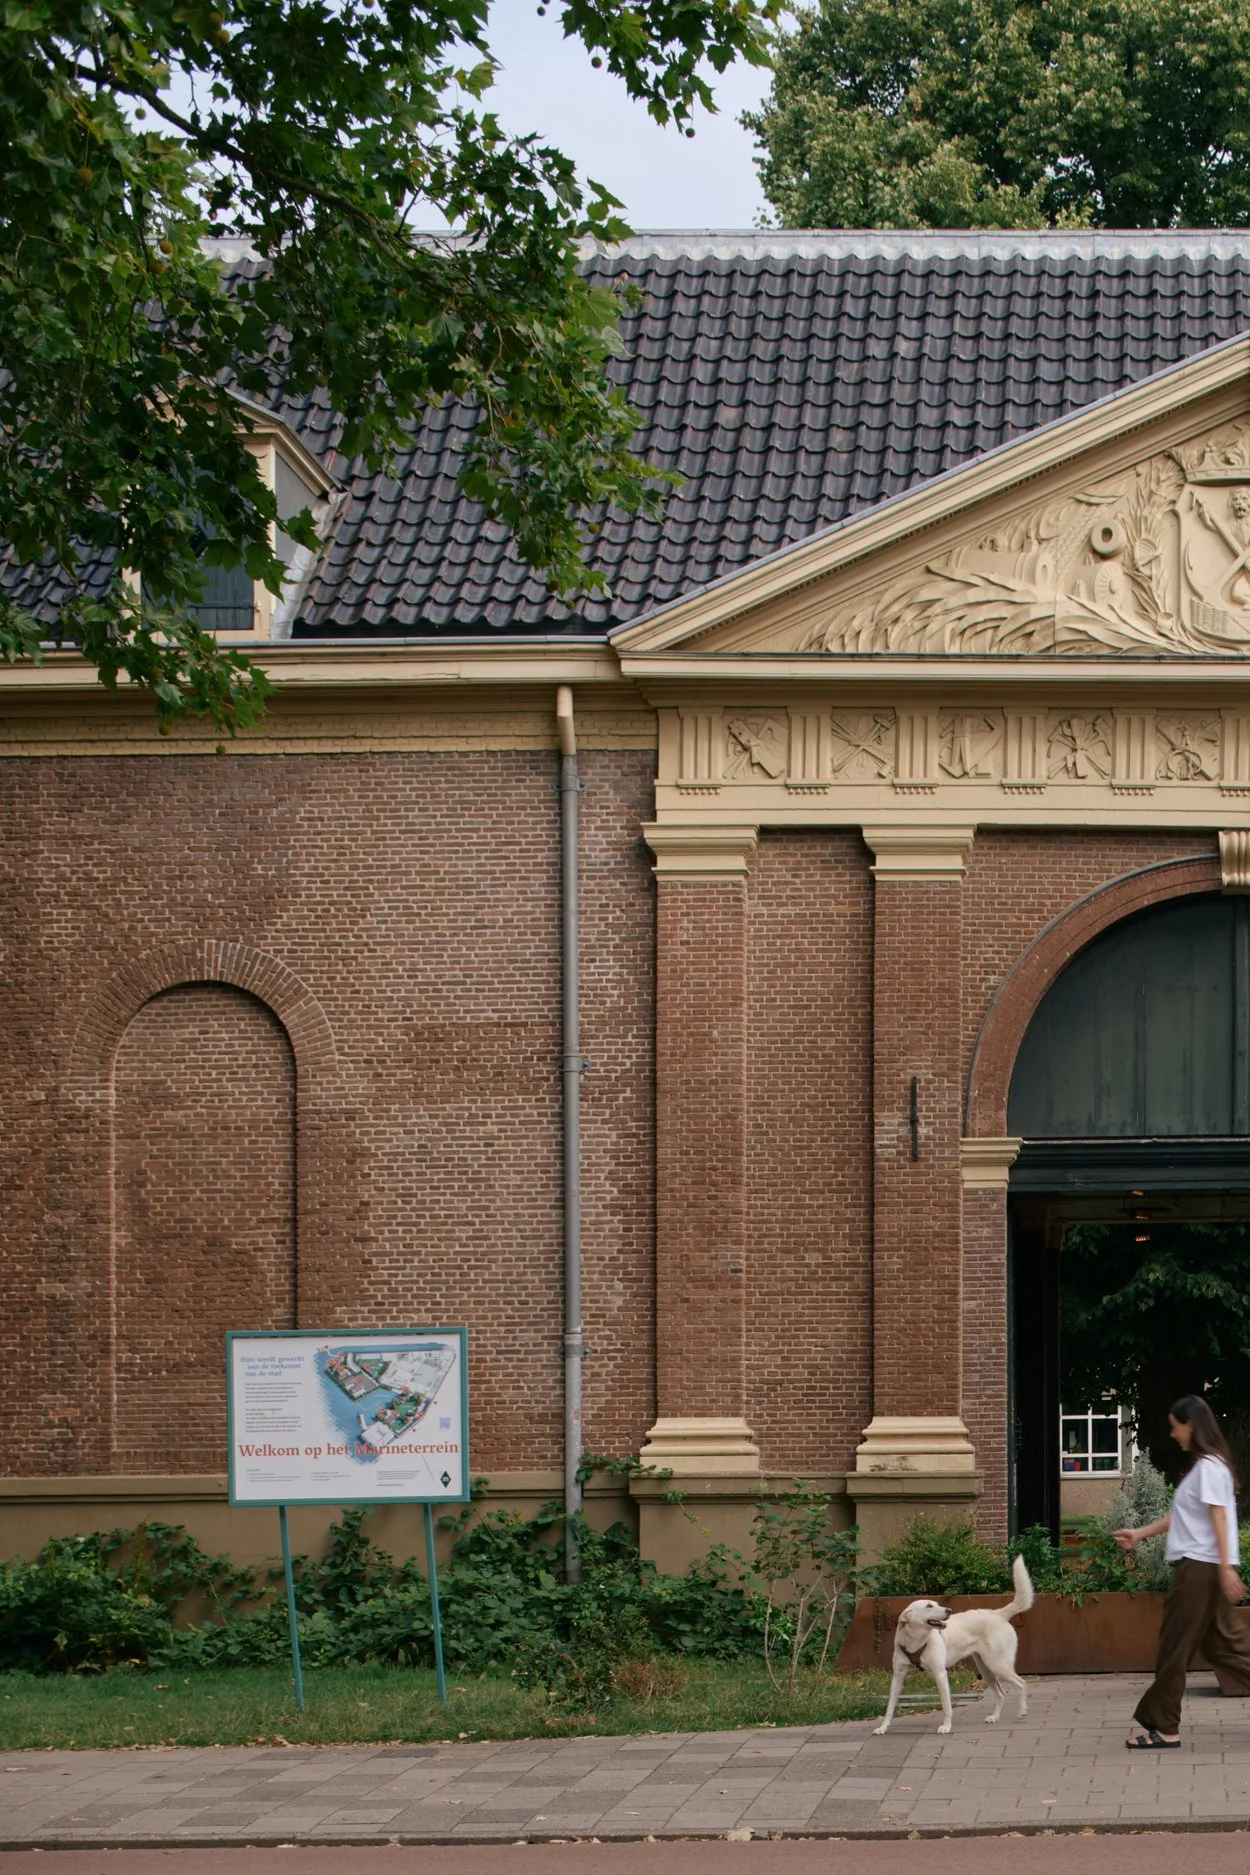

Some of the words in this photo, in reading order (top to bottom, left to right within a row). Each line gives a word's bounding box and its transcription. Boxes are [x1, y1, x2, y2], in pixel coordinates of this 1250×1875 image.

[239, 1444, 300, 1457] Welkom
[304, 1447, 322, 1459] op
[327, 1443, 351, 1456] het
[355, 1441, 459, 1455] Marineterrein
